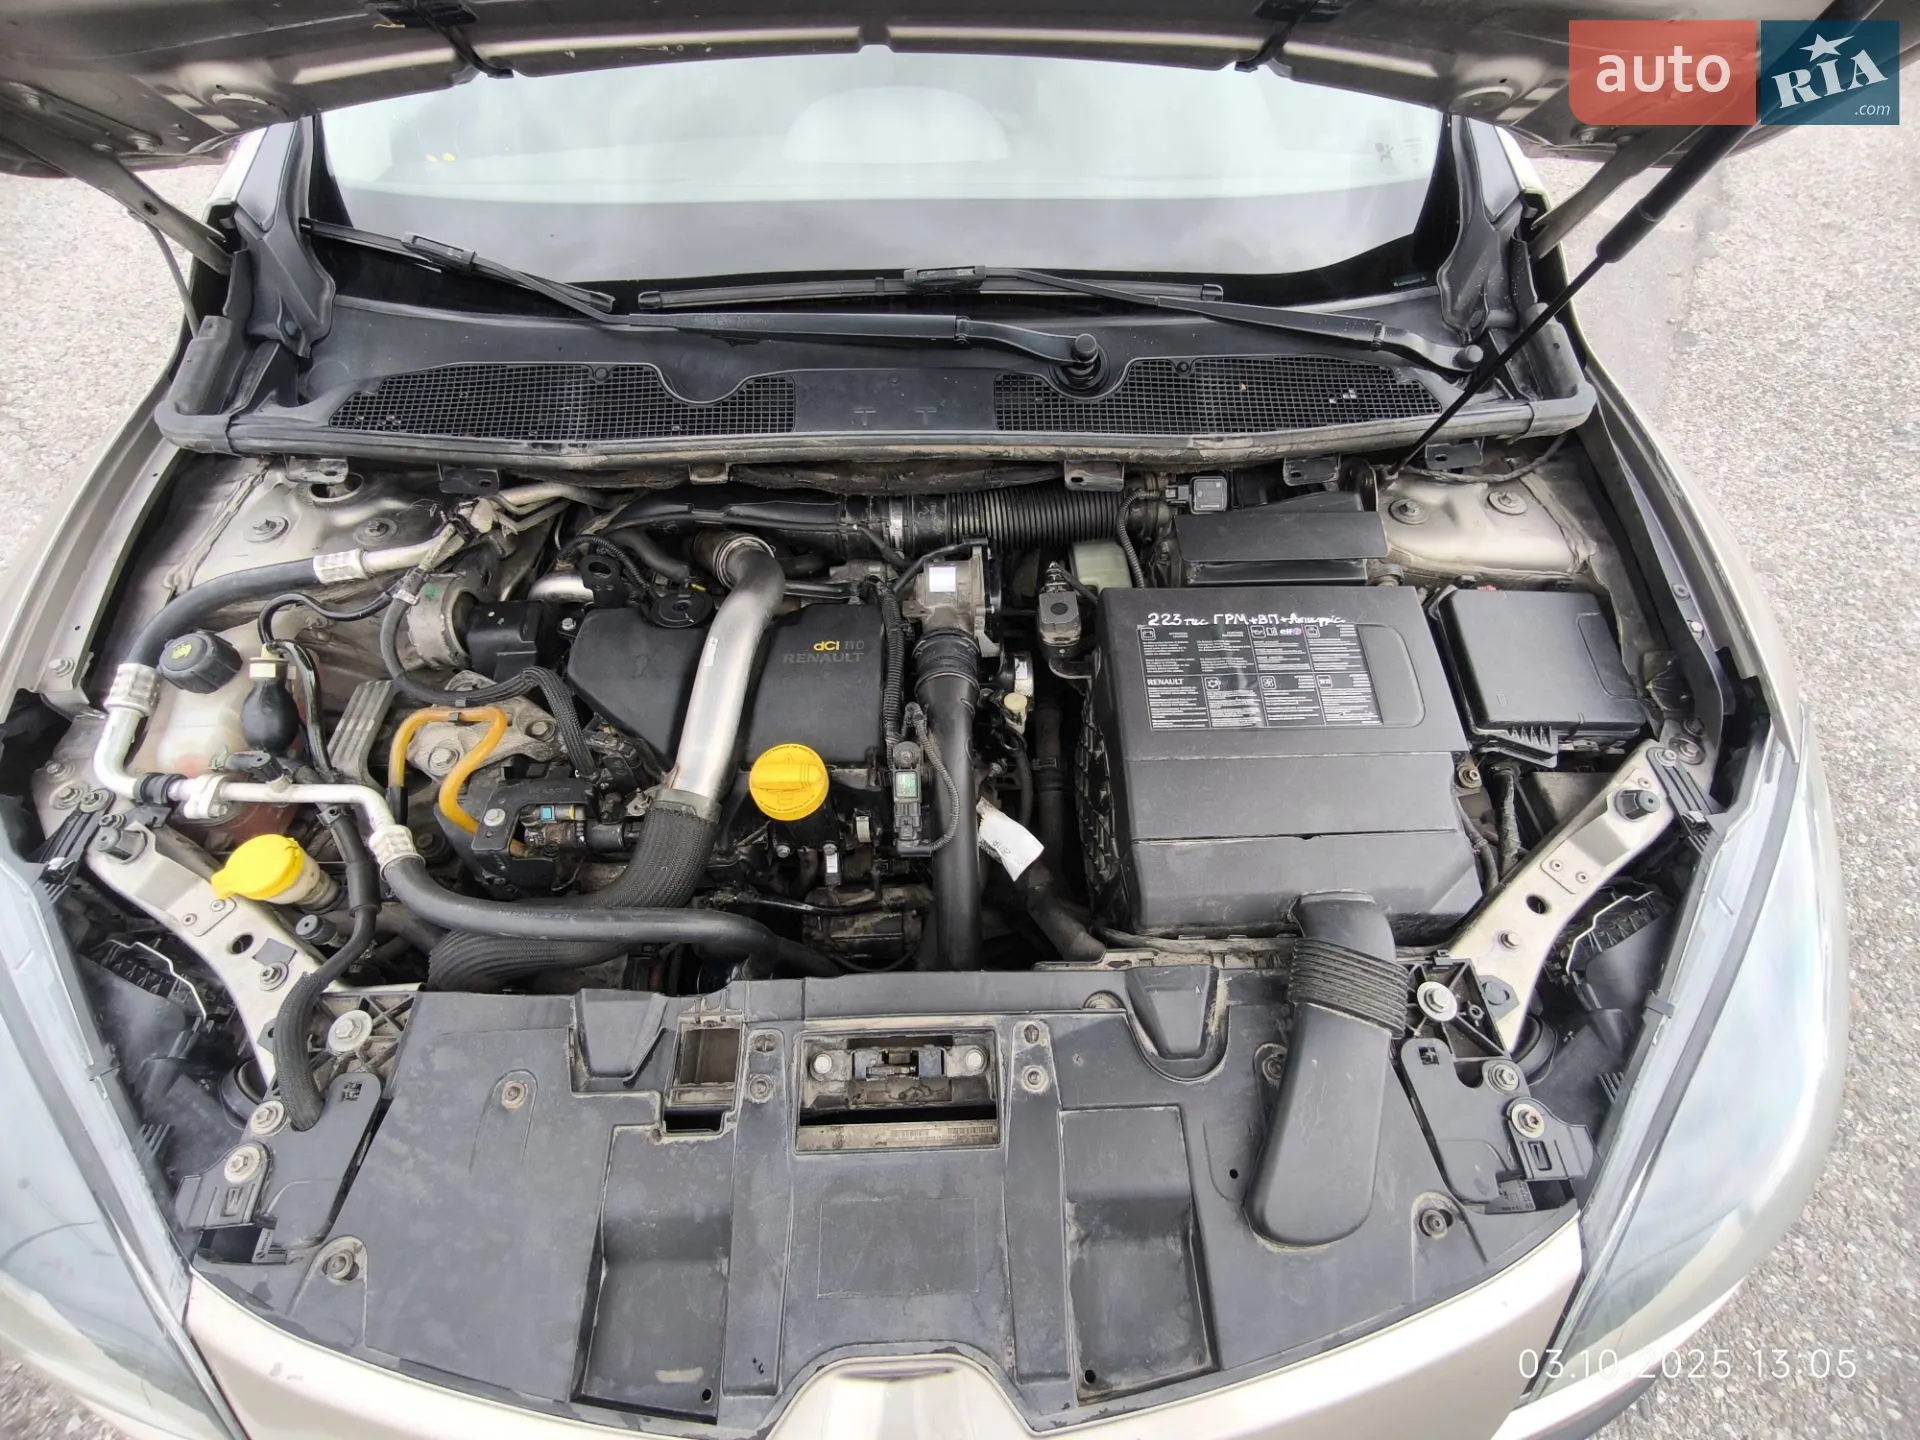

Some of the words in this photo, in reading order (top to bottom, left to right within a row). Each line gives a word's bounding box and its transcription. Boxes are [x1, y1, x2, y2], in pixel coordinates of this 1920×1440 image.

[844, 640, 865, 650] 110
[782, 652, 865, 664] RENAULT
[1147, 678, 1184, 686] RENAULT
